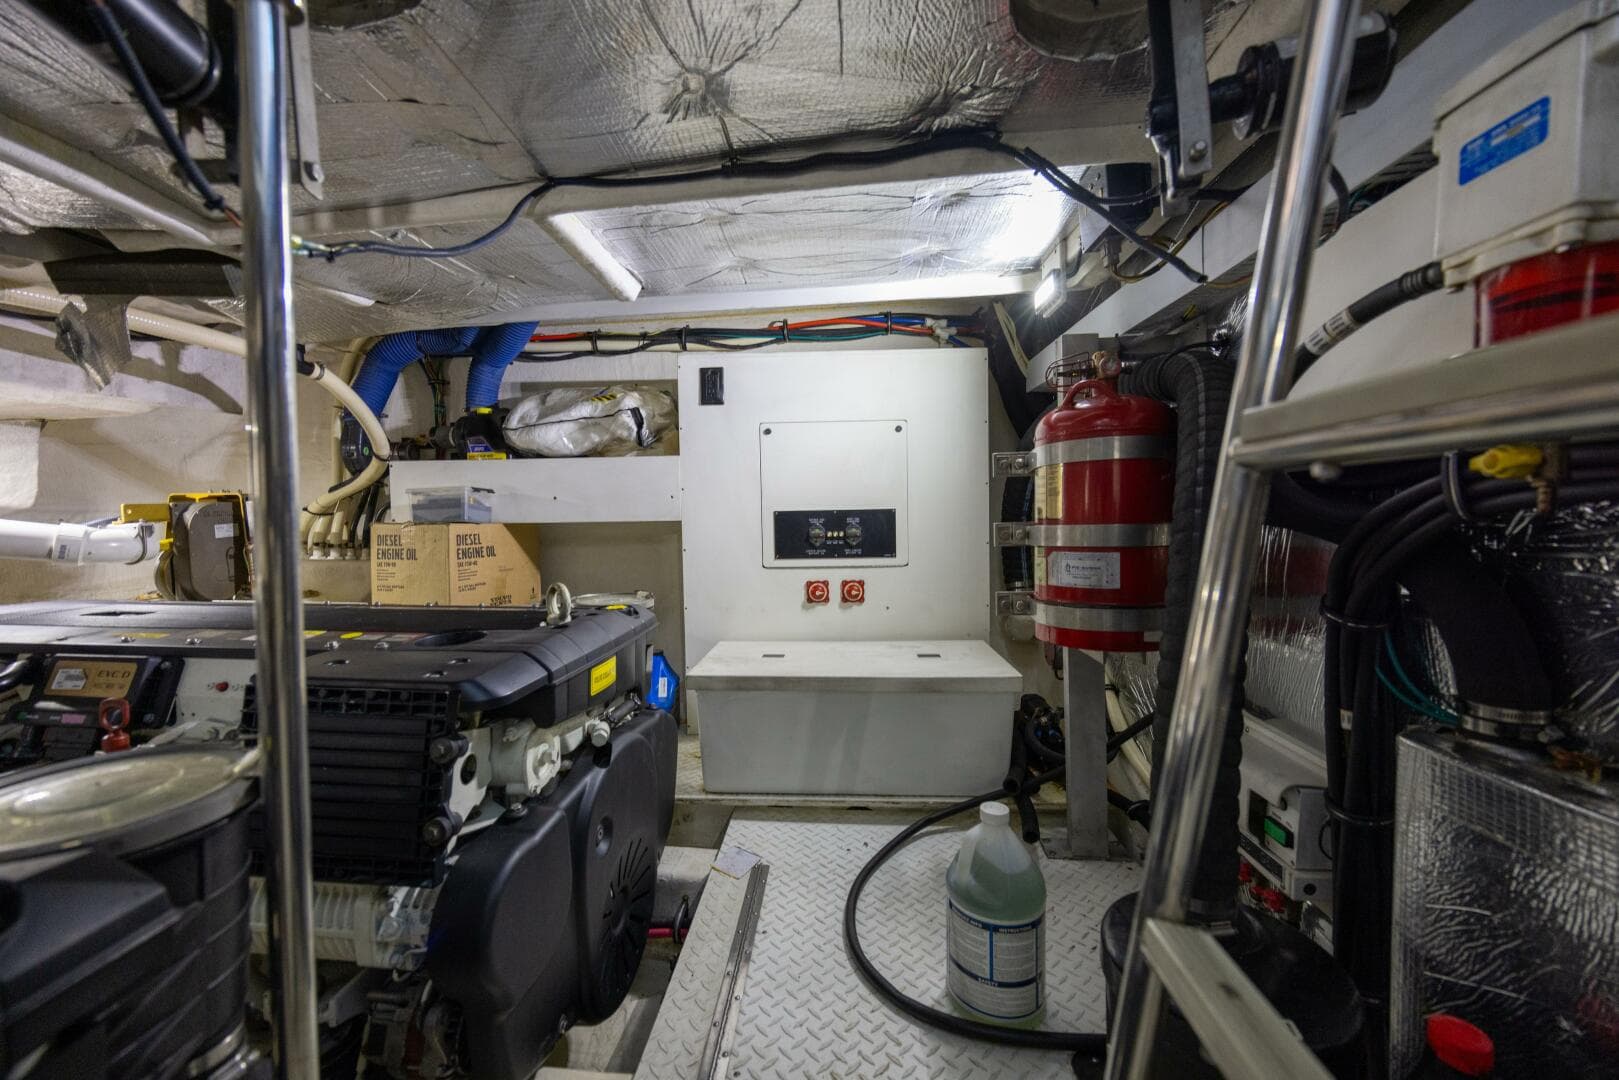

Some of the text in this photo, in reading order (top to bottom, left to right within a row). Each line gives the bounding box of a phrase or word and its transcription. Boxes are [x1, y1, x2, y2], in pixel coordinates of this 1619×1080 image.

[377, 534, 402, 547] DIESEL
[456, 533, 482, 546] DIESEL
[377, 548, 418, 561] ENGINE OIL
[457, 545, 497, 560] ENGINE OIL
